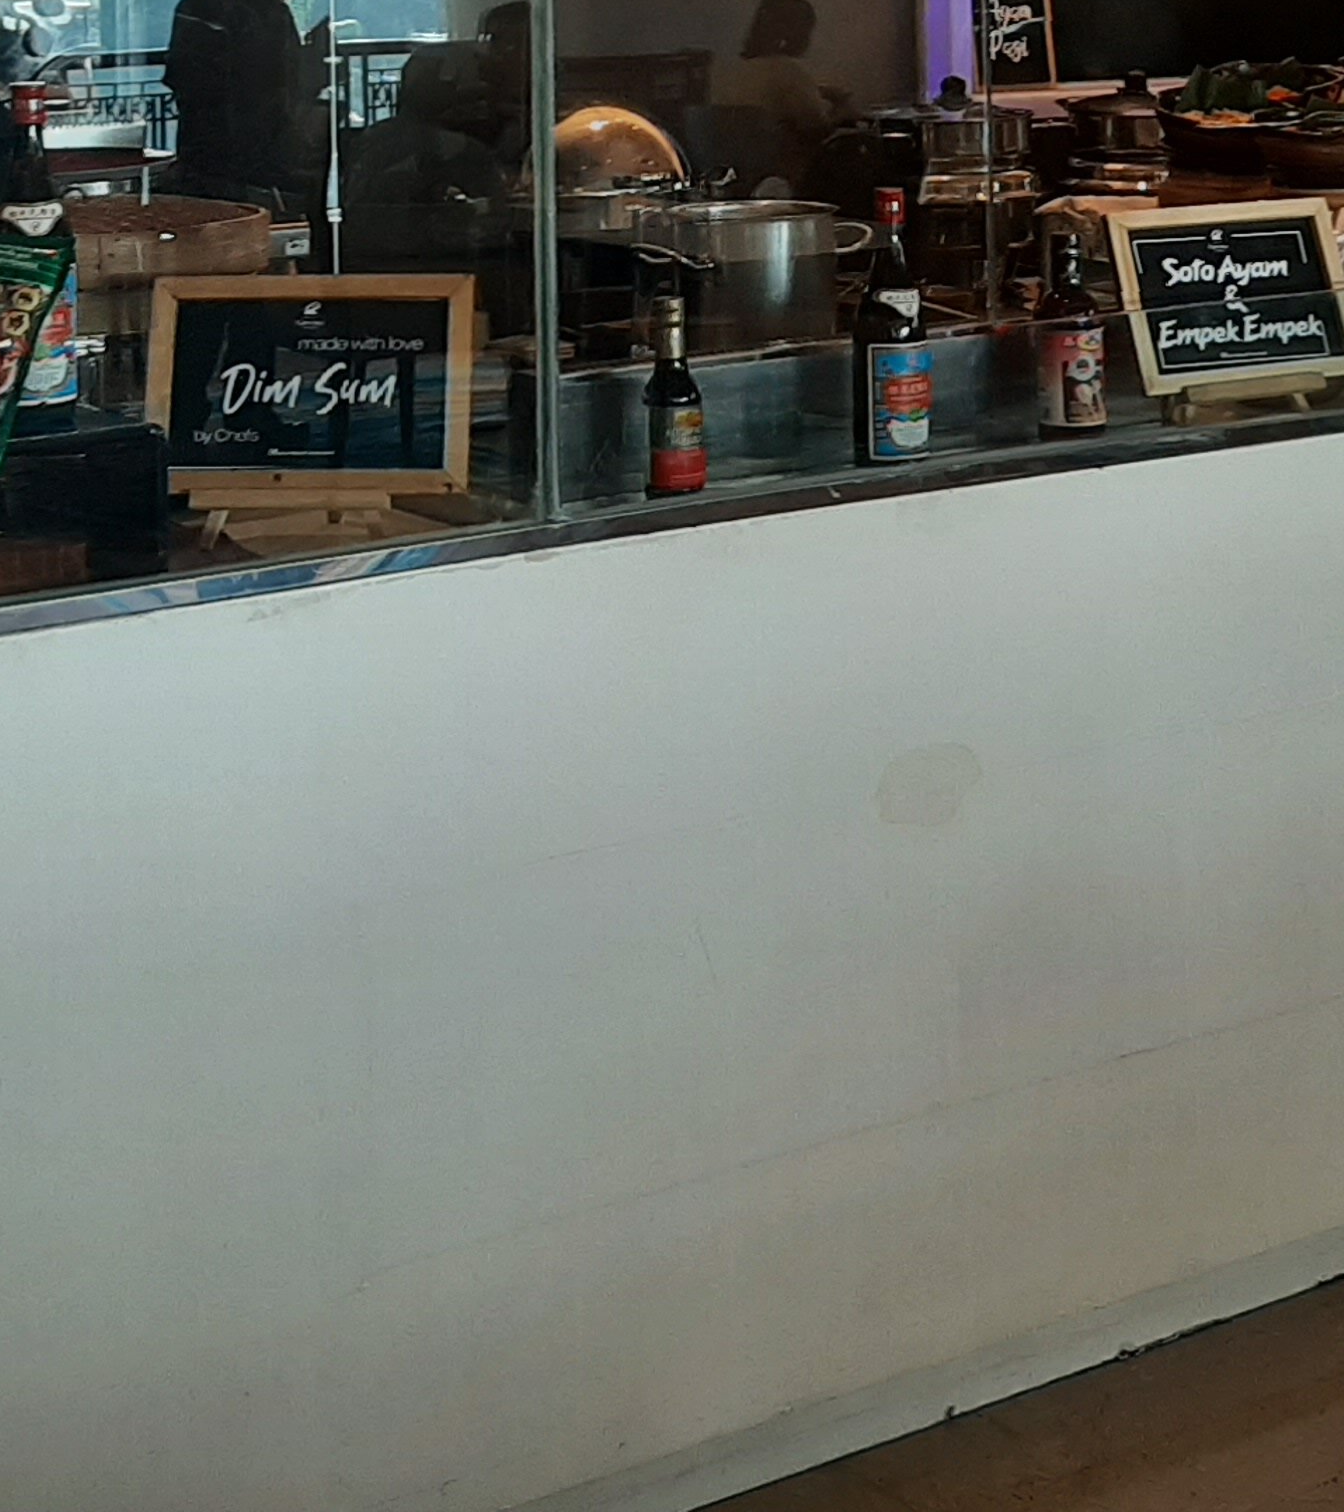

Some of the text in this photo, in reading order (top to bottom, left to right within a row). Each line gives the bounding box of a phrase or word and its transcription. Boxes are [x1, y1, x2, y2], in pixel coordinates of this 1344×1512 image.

[1162, 255, 1289, 287] Soto Ayam
[1223, 284, 1250, 313] &
[297, 334, 425, 352] made with love
[1158, 313, 1324, 351] Empek Empek
[220, 361, 398, 416] Dim Sum
